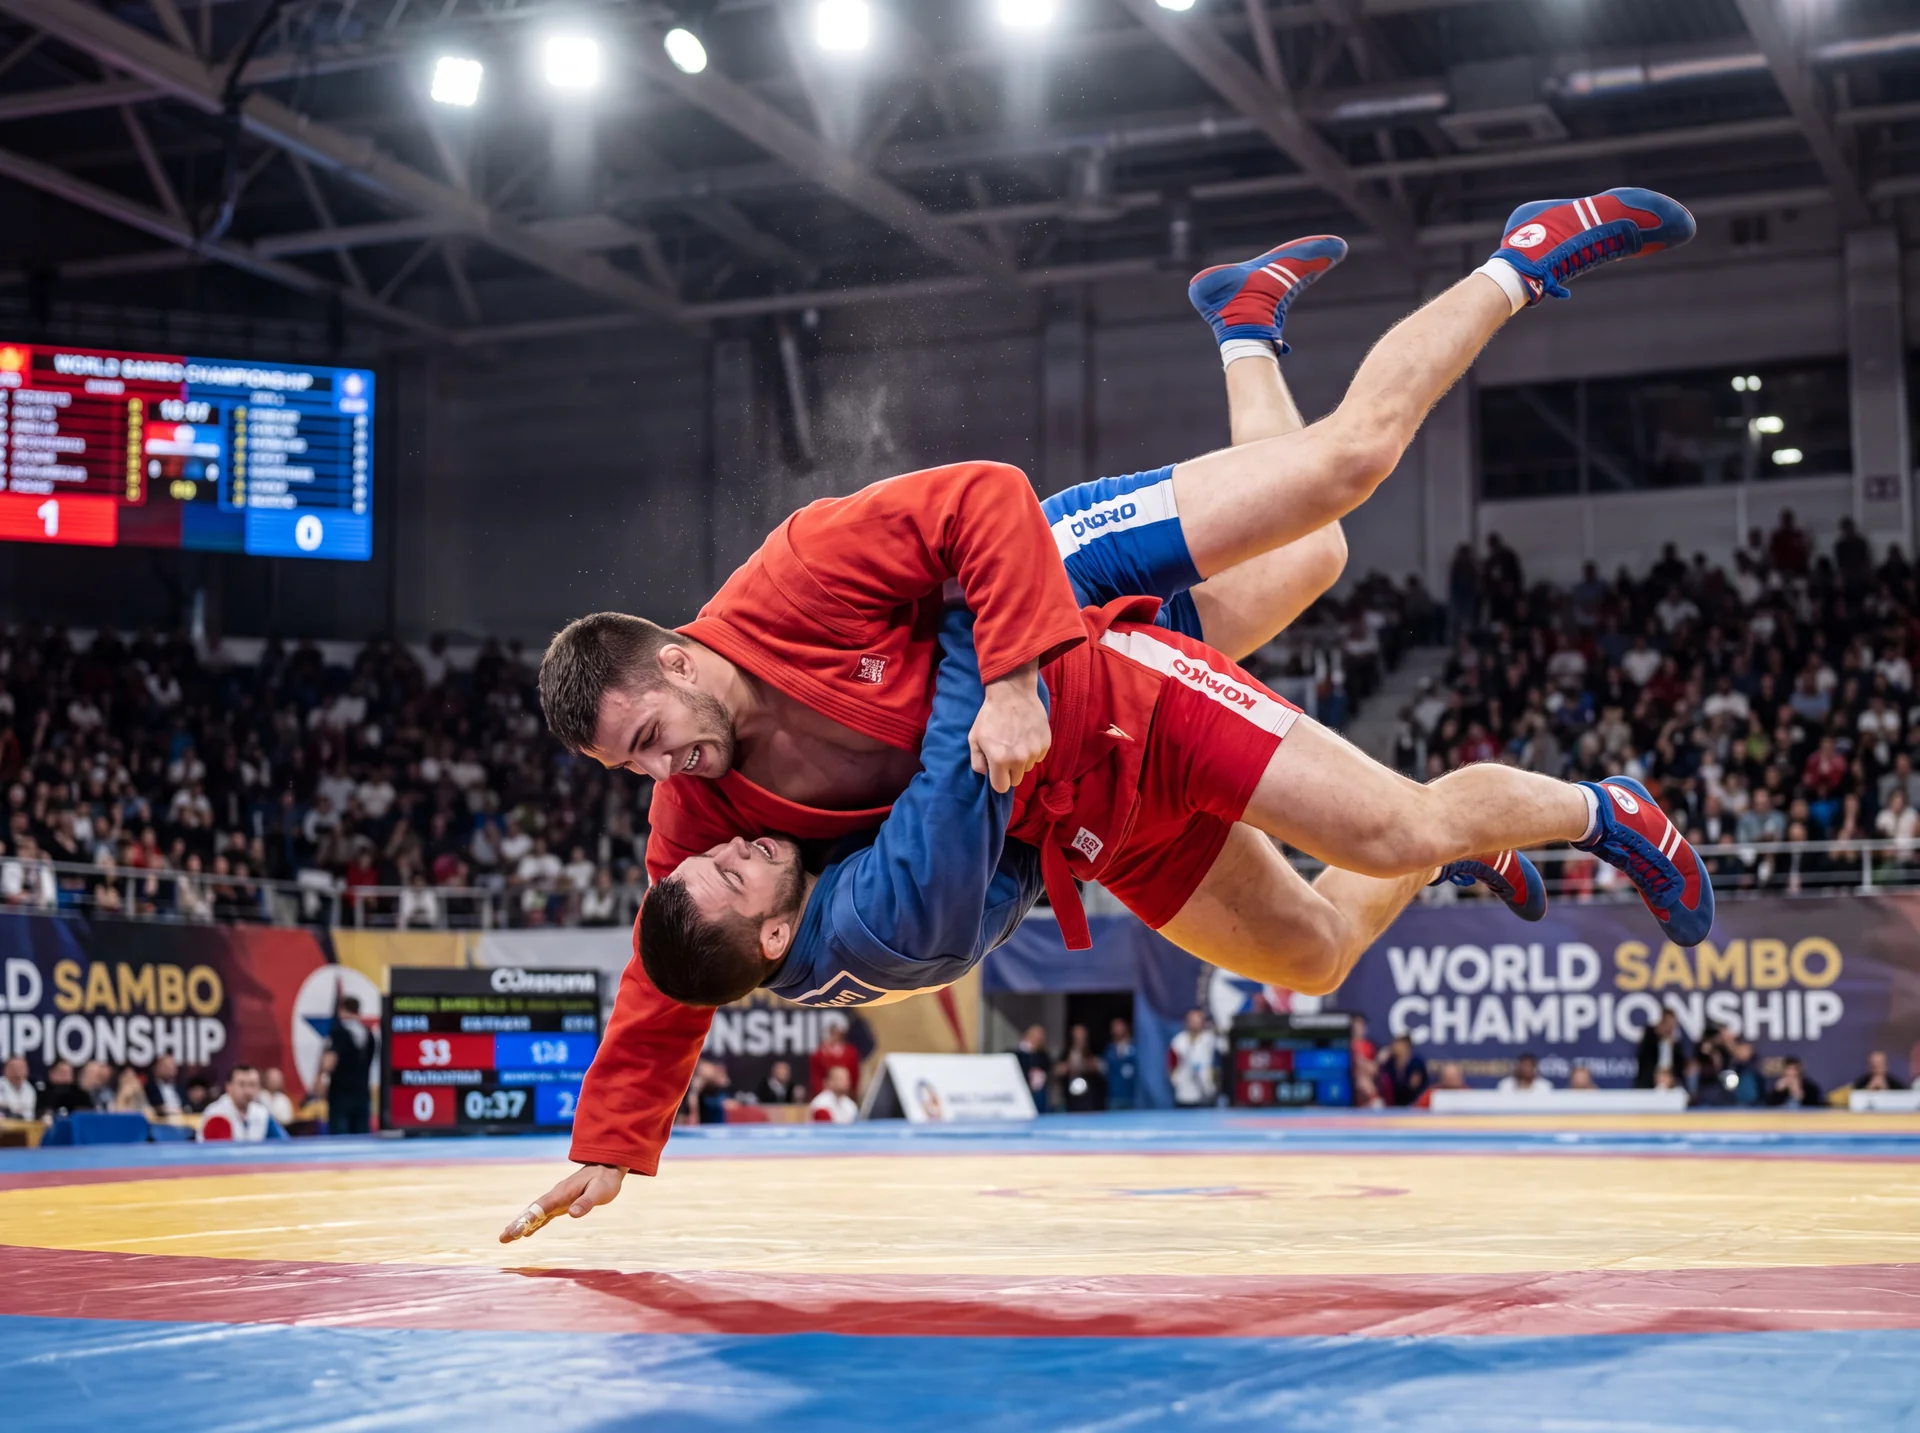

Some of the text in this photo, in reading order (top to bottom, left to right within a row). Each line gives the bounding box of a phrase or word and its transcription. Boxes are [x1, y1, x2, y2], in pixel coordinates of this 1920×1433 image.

[37, 500, 58, 536] 1
[296, 515, 323, 551] 0
[0, 957, 224, 1016] D SAMBO
[1387, 936, 1843, 995] WORLD SAMBO
[0, 1013, 226, 1067] PIONSHIP
[703, 1009, 849, 1056] NSHIP
[1387, 990, 1844, 1044] CHAMPIONSHIP
[413, 1092, 434, 1121] 0
[465, 1090, 527, 1119] 0:37
